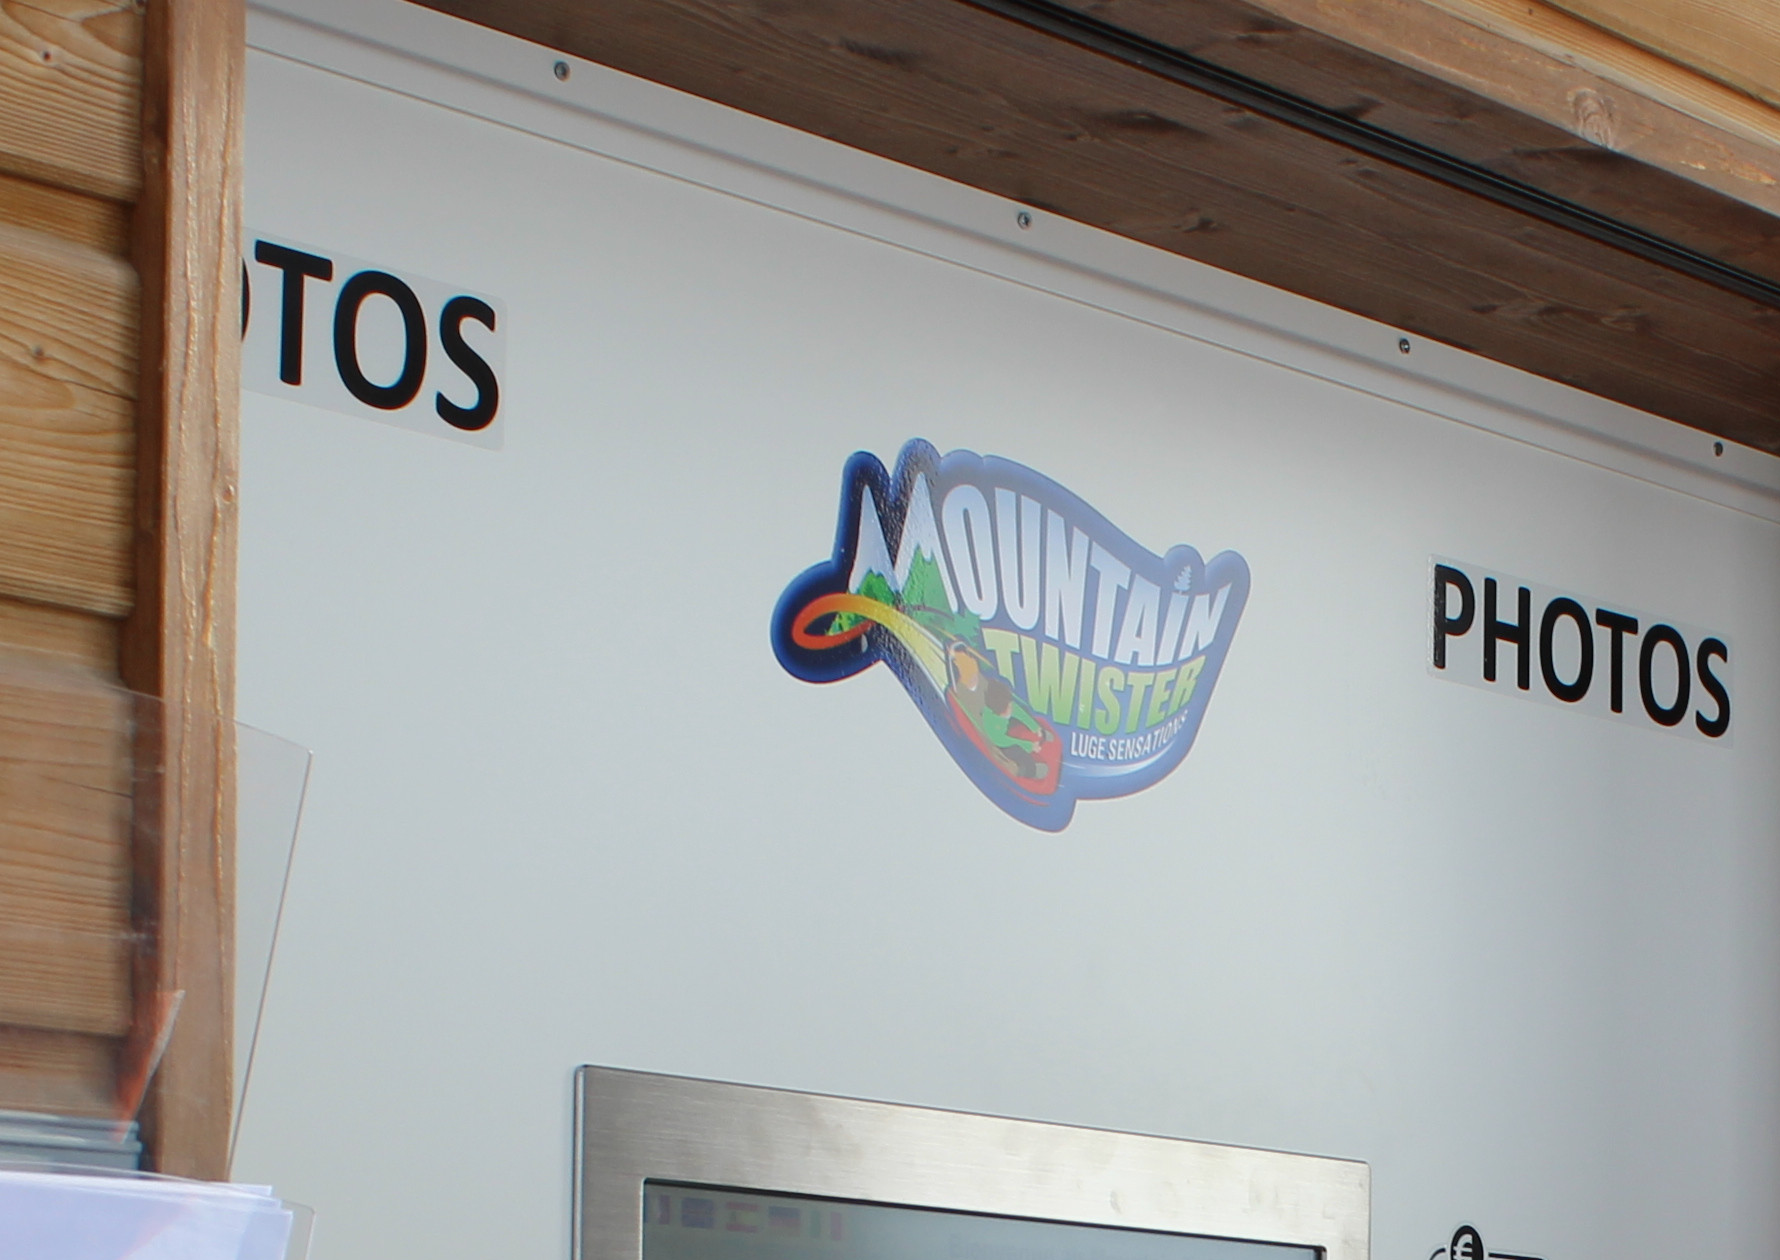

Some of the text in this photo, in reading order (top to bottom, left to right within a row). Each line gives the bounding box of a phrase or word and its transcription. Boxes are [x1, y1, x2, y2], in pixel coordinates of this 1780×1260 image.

[242, 239, 499, 432] TOS
[849, 471, 1231, 666] MOUNTAIN
[1433, 563, 1731, 738] PHOTOS
[982, 627, 1206, 735] TWISTER
[1071, 732, 1106, 760] LUGE
